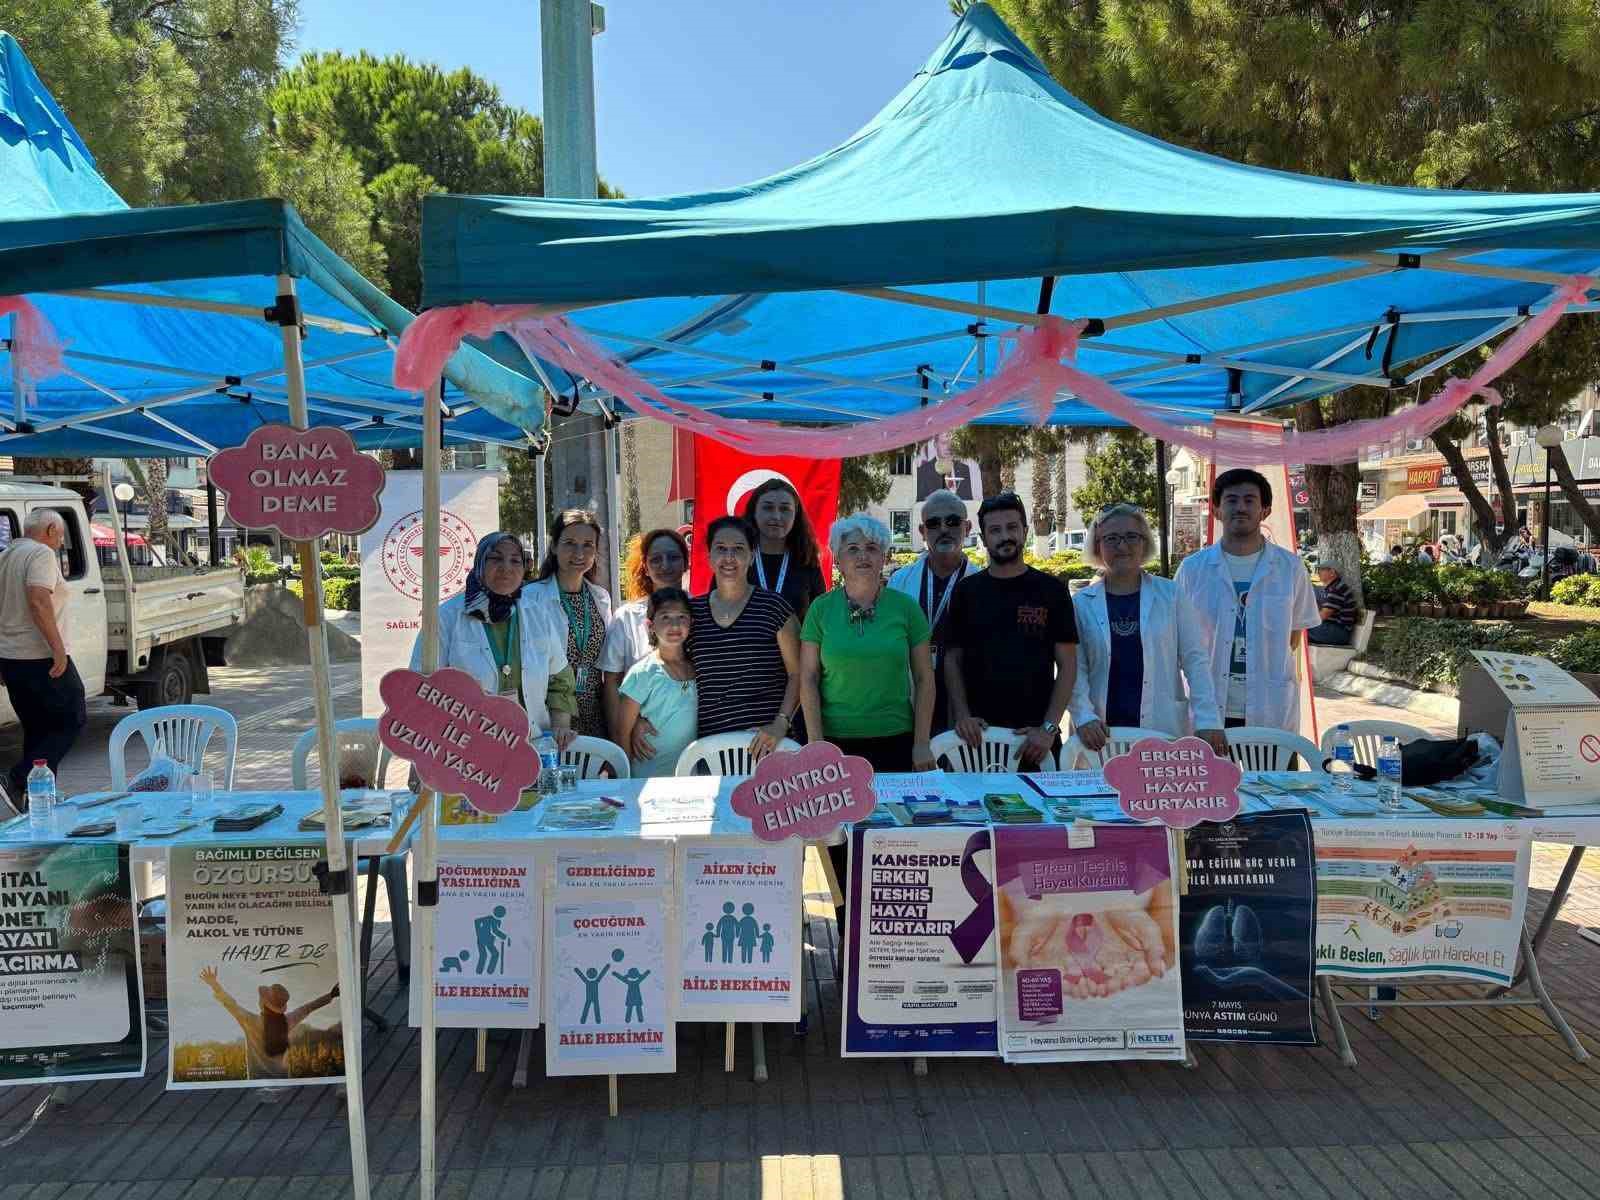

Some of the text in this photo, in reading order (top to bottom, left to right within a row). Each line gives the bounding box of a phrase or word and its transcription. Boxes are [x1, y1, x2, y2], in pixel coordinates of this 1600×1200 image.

[261, 443, 337, 461] BANA
[250, 469, 348, 487] OLMAZ
[1409, 471, 1438, 485] HARPUT
[262, 495, 337, 513] DEME
[417, 682, 520, 750] ERKEN TANI
[441, 720, 472, 749] İLE
[390, 720, 502, 793] UZUN YAŞAM
[1140, 750, 1204, 762] ERKEN
[753, 762, 850, 805] KONTROL
[1146, 781, 1209, 793] HAYAT
[763, 788, 856, 831] ELİNİZDE
[1129, 796, 1229, 811] KURTARIR
[195, 846, 321, 860] BAĞIMLI DEĞİLSEN
[872, 854, 960, 867] KANSERDE
[194, 863, 317, 884] ÖZGÜRSÜ
[437, 864, 527, 877] DOĞUMUNDAN
[566, 864, 656, 878] GEBELİĞİNDE
[703, 861, 777, 877] AİLEN İÇİN
[872, 870, 927, 883] ERKEN
[871, 905, 927, 918] HAYAT
[186, 915, 238, 925] MADDE,
[573, 915, 646, 930] ÇOCUĞUNA
[187, 925, 304, 938] ALKOL VE TÜTÜNE
[870, 921, 953, 935] KURTARIR
[300, 942, 329, 960] DE
[435, 982, 529, 998] İLE HEKİMİN
[683, 976, 790, 992] AİLE HEKİMİN
[1218, 1001, 1242, 1009] MAYIS
[1184, 1010, 1279, 1022] ÜNYA ASTIM GÜNÜ
[560, 1028, 664, 1045] AİLE HEKİMİN
[1137, 1034, 1174, 1043] KETEM
